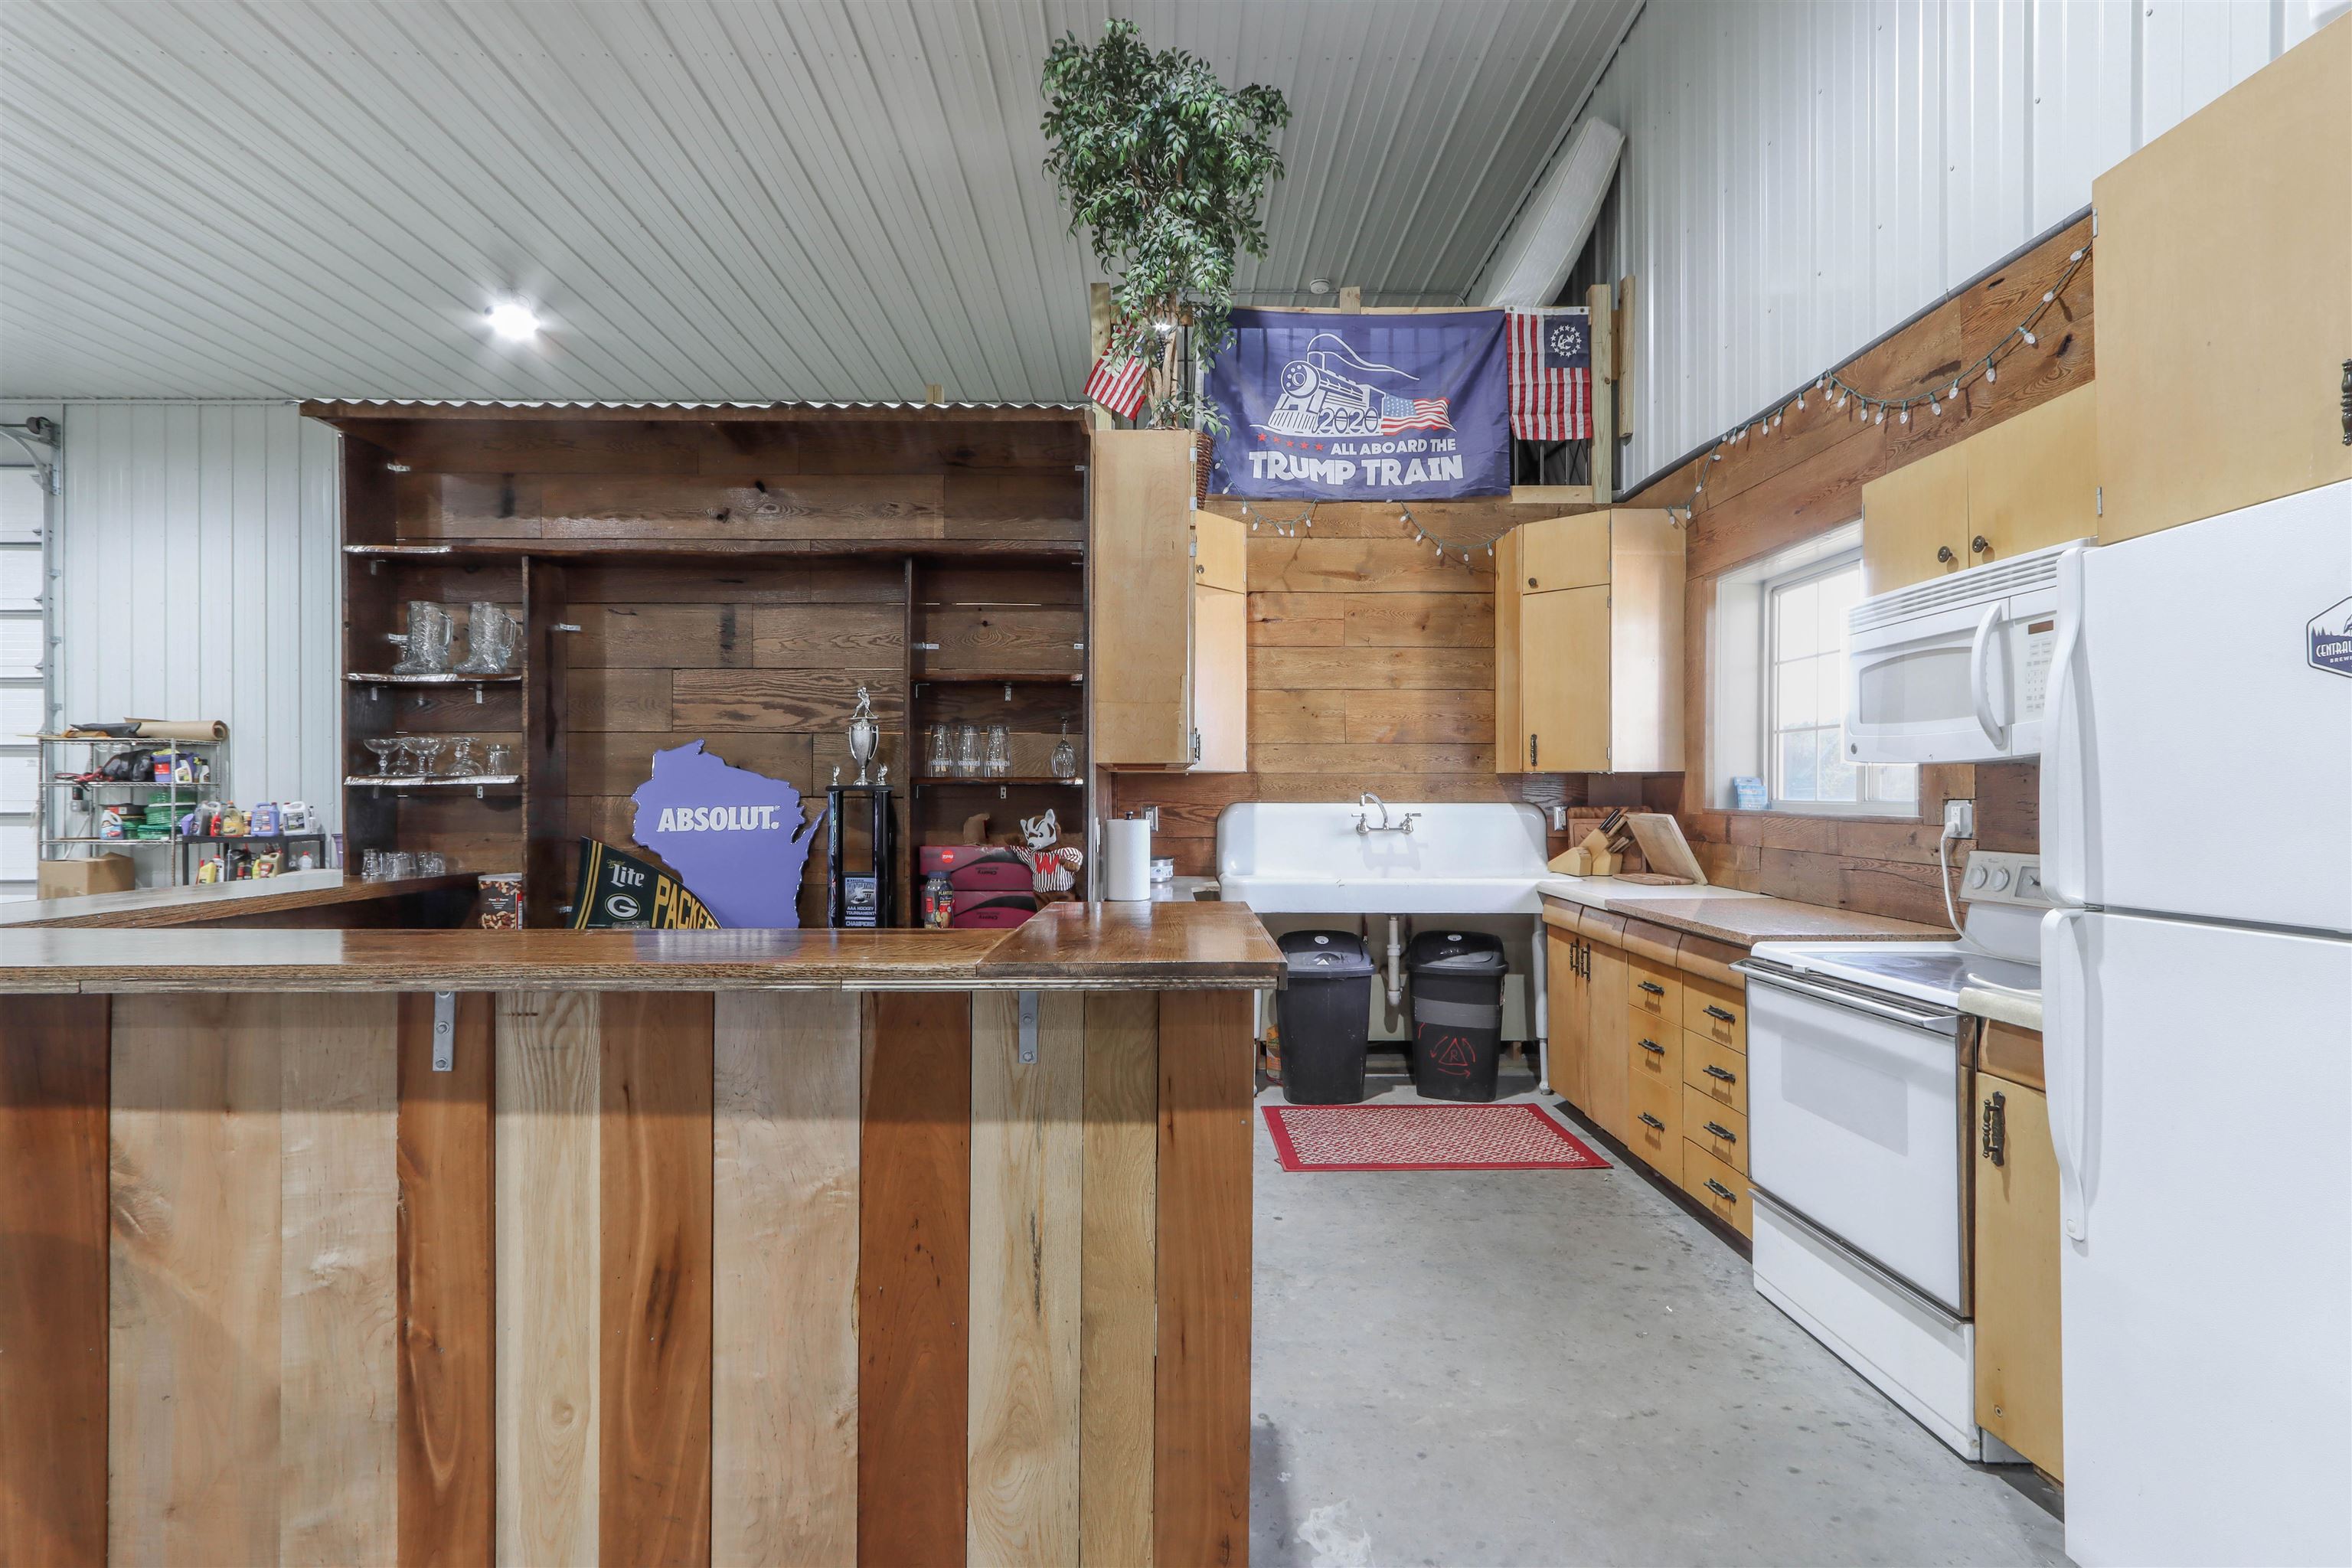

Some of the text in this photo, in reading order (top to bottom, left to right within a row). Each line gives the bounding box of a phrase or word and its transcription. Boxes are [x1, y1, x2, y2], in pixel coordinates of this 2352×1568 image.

[1318, 407, 1378, 433] 2020
[1331, 438, 1456, 456] ALL ABOARD THE
[1249, 451, 1464, 486] TRUMP TRAIN
[2316, 640, 2352, 657] CENTRAL
[1034, 853, 1060, 874] W
[610, 864, 645, 887] Lite
[606, 894, 638, 918] G
[652, 874, 718, 929] PACKER
[1449, 1050, 1459, 1063] R
